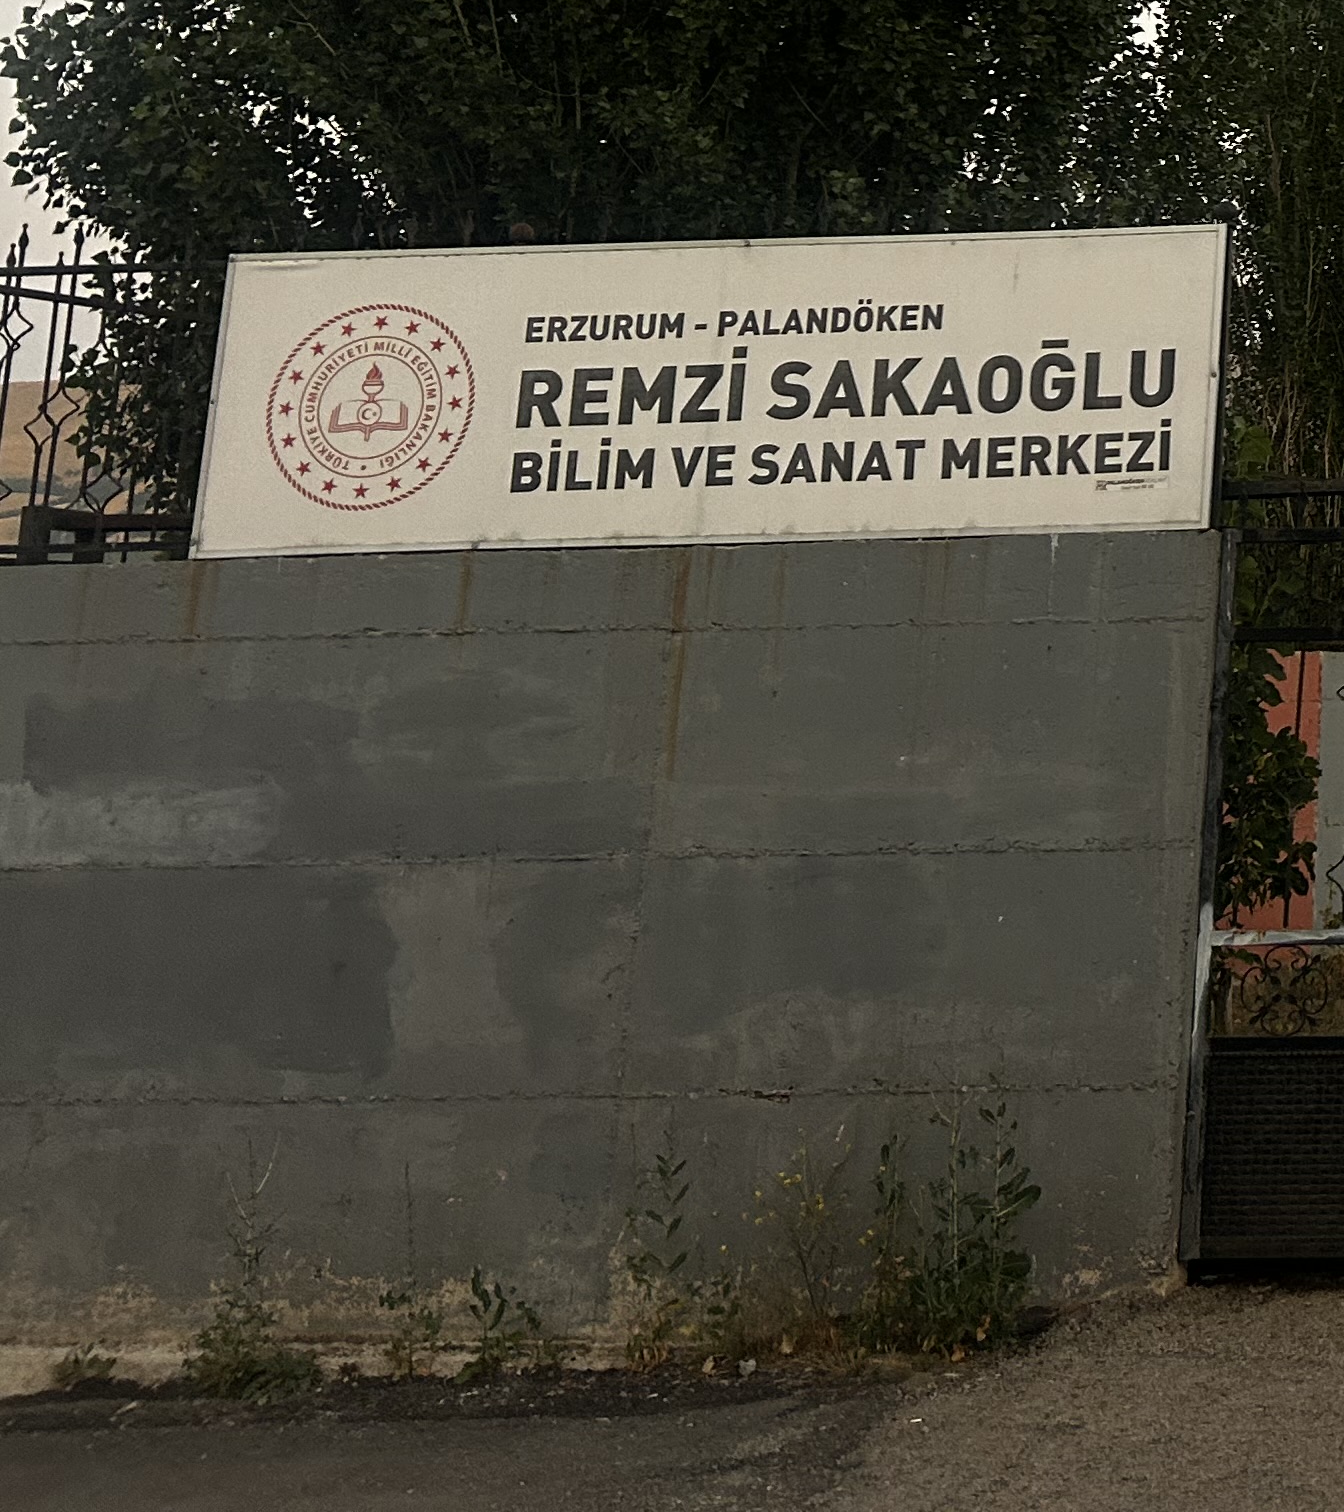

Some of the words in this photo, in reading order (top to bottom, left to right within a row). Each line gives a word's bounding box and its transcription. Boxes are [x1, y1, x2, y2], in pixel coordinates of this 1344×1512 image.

[525, 312, 685, 343] ERZURUM
[717, 299, 944, 337] PALANDÖKEN
[373, 341, 413, 359] MİLLİ
[410, 355, 437, 400] EĞİTİM
[304, 341, 369, 423] CUMHURİYETİ
[515, 345, 748, 428] REMZİ
[766, 339, 1176, 420] SAKAOĞLU
[306, 427, 350, 471] TÜRKİYE
[379, 403, 437, 469] BAKANLIĞI
[510, 437, 655, 493] BİLİM
[671, 445, 736, 487] VE
[748, 439, 926, 485] SANAT
[941, 418, 1172, 480] MERKEZİ
